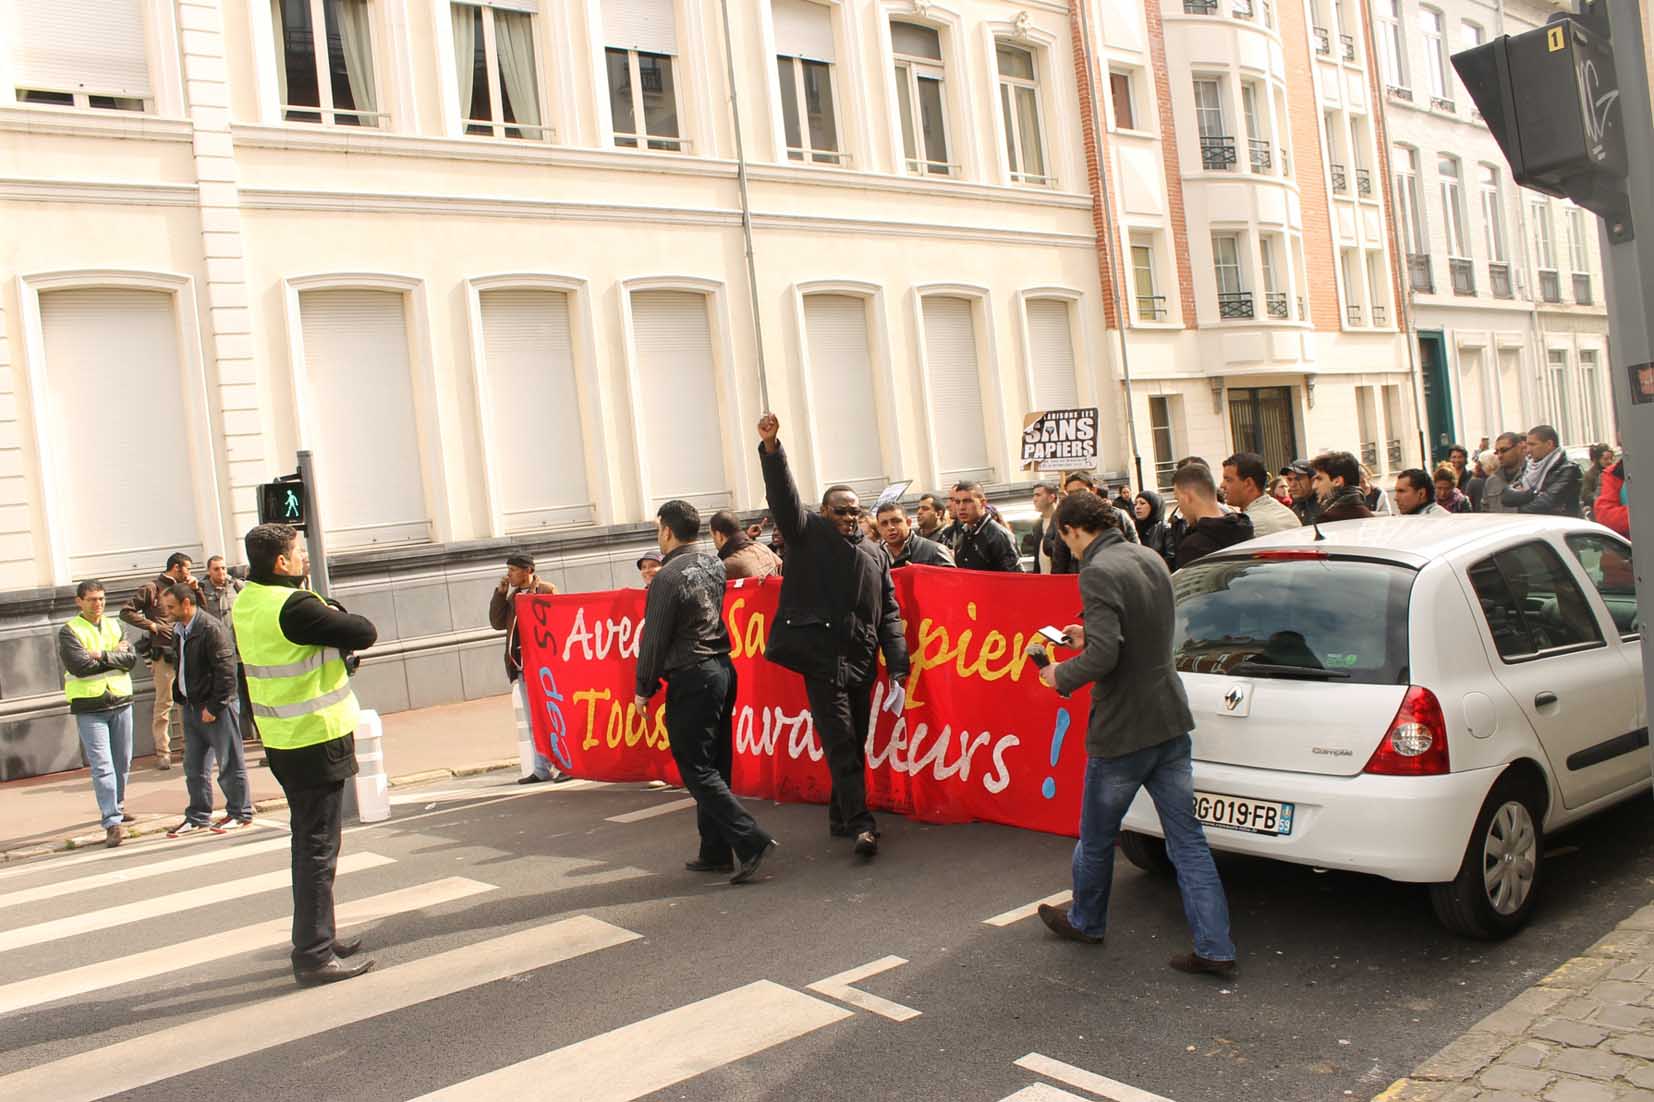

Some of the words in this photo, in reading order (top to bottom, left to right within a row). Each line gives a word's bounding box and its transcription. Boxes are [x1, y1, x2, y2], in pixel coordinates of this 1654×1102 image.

[1551, 31, 1559, 47] 1
[1023, 417, 1095, 444] SANS
[573, 688, 670, 751] Tous
